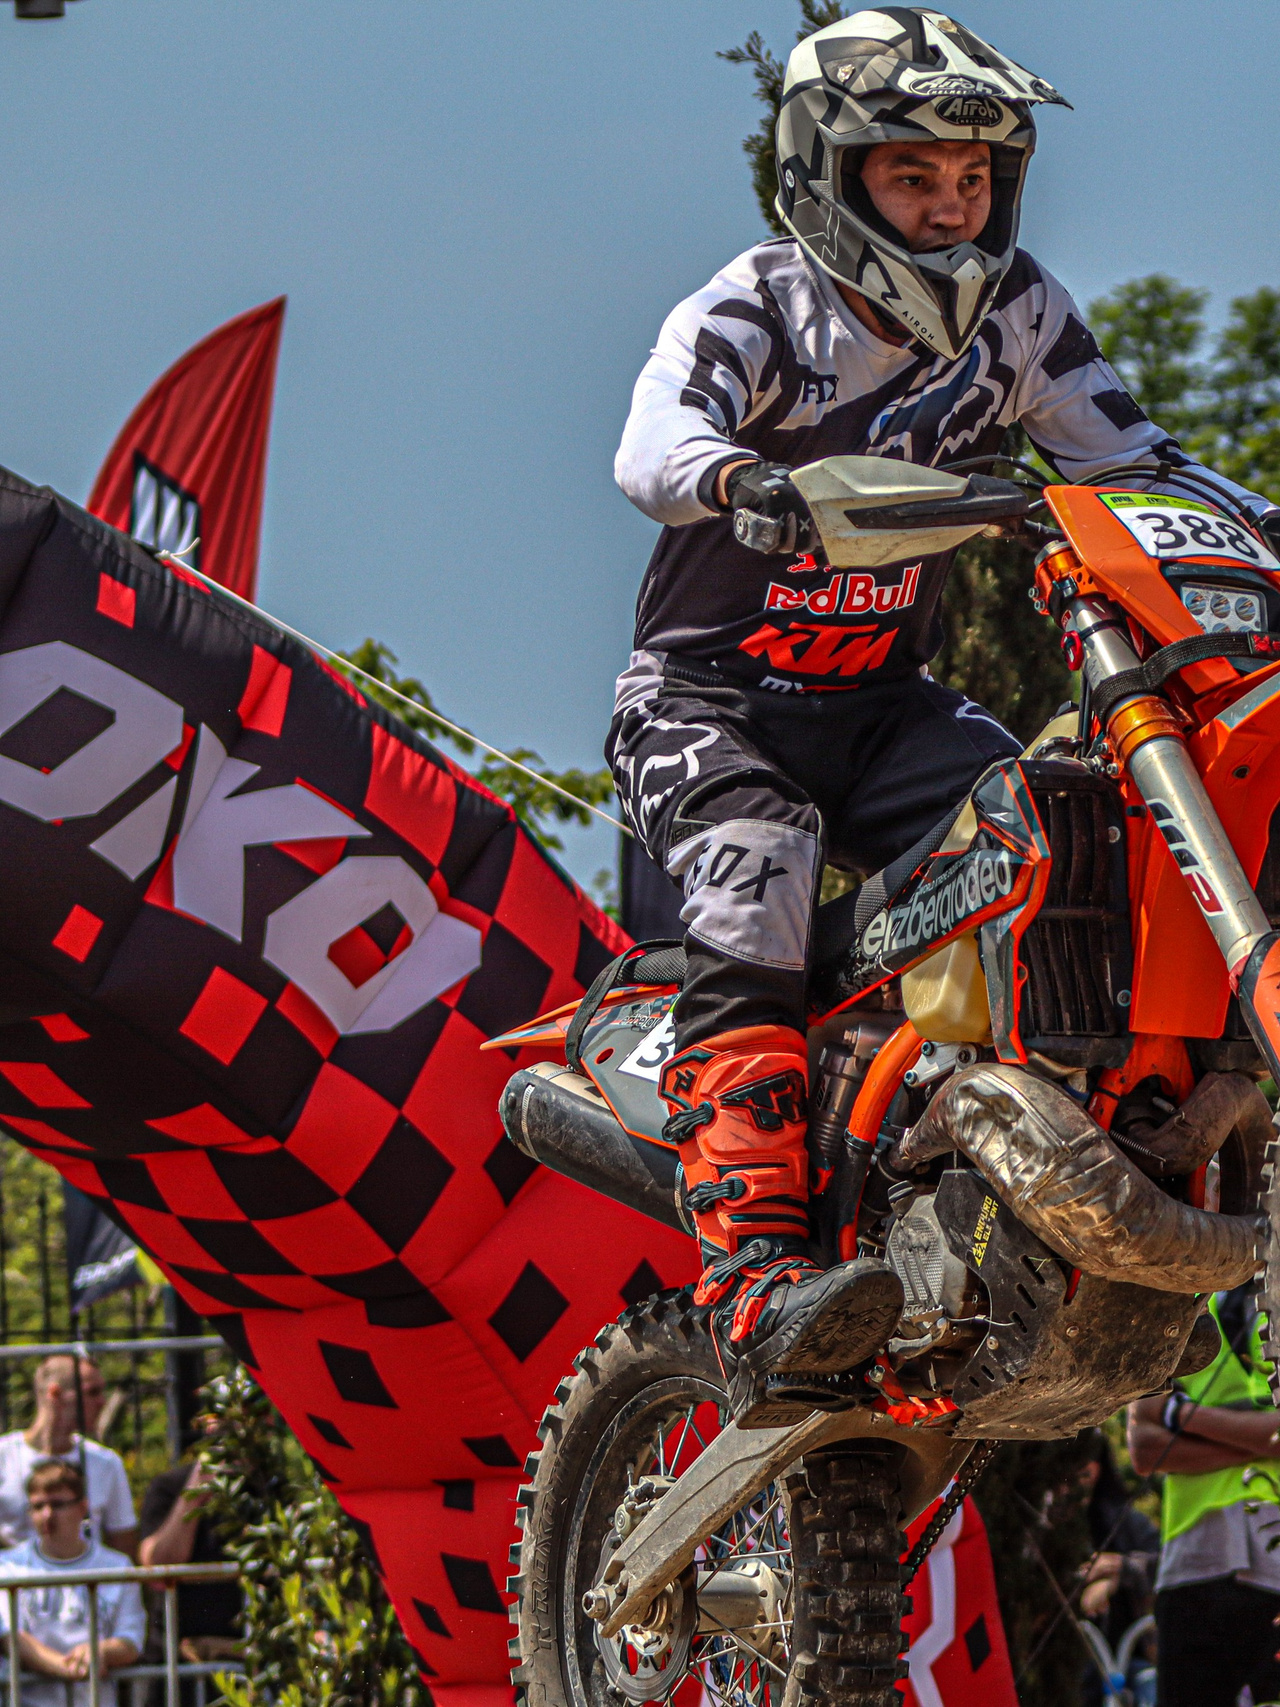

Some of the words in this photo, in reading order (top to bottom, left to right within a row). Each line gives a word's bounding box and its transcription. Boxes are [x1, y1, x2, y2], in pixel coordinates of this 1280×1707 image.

[902, 310, 935, 341] AIROH
[1136, 512, 1260, 559] 388
[737, 621, 900, 676] KTM
[862, 849, 1012, 956] erzbergrodeo
[973, 1195, 993, 1241] ENDURO
